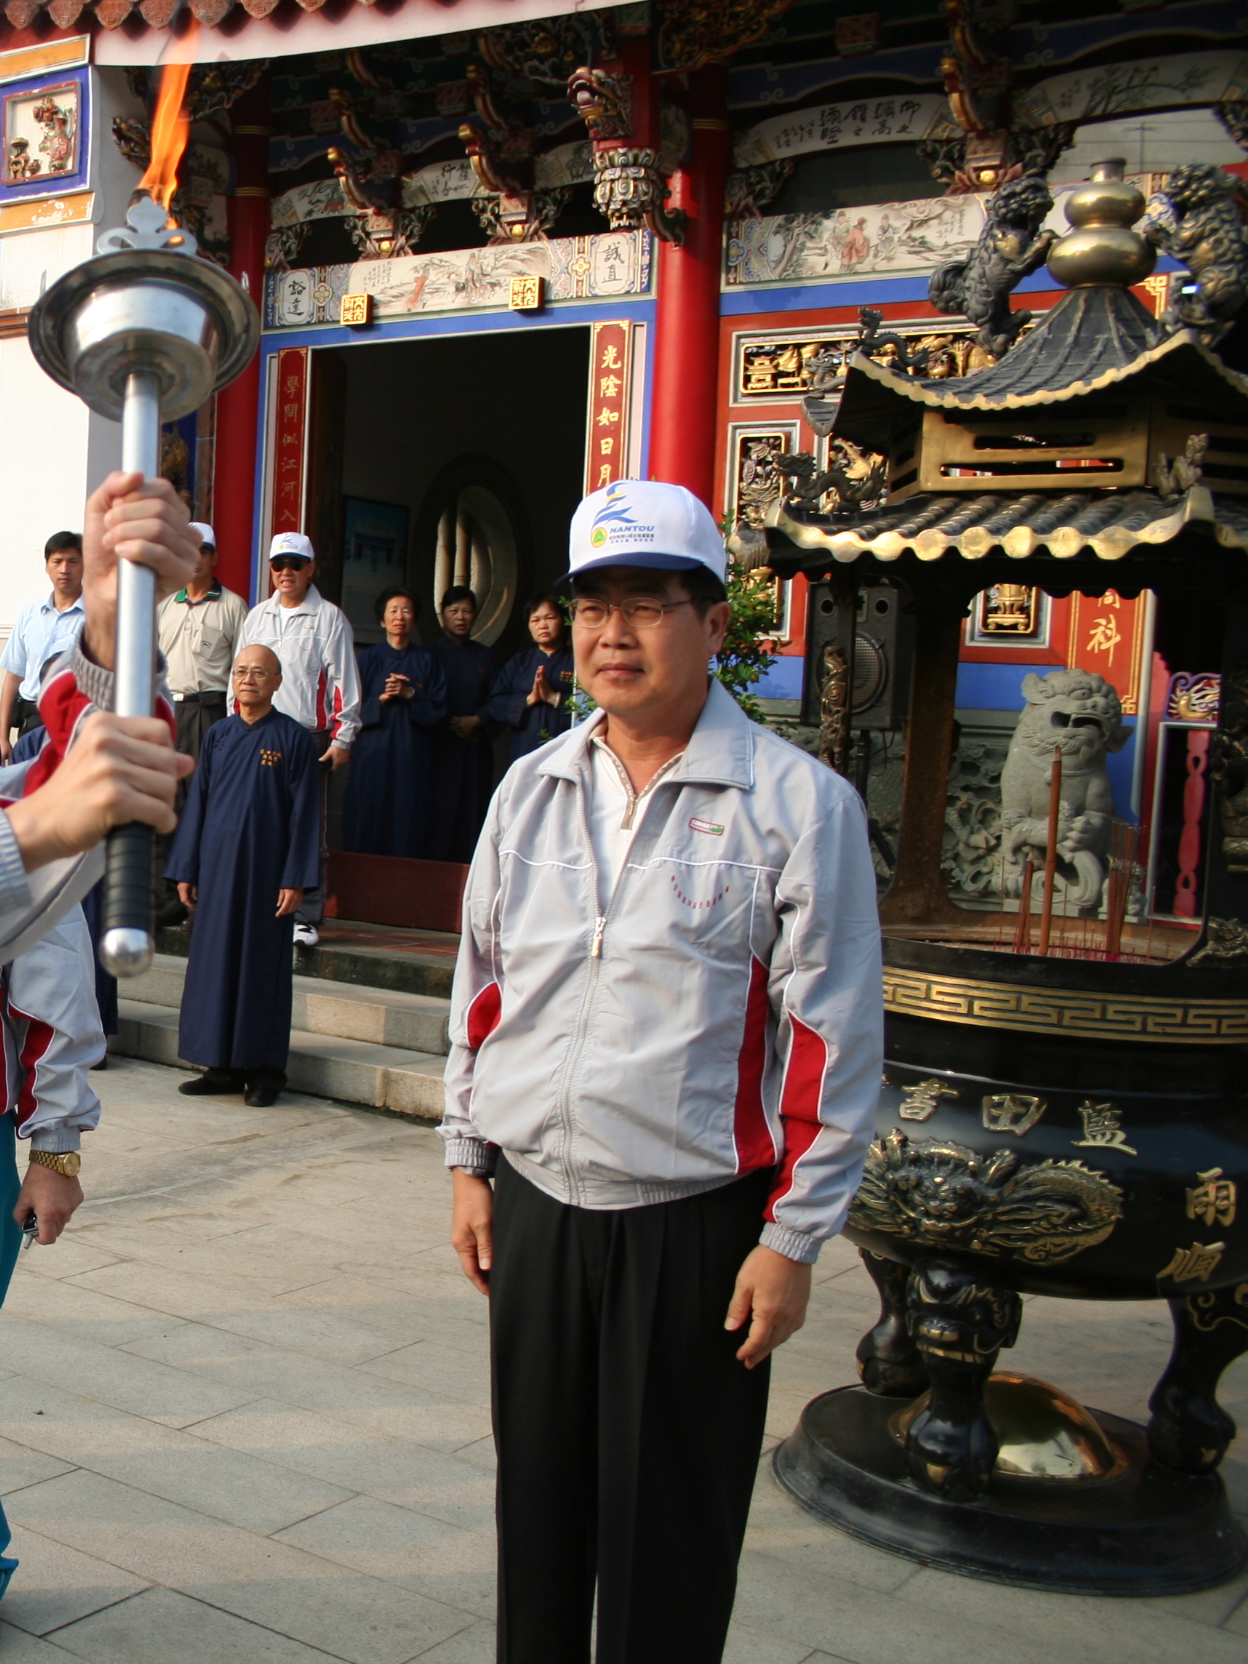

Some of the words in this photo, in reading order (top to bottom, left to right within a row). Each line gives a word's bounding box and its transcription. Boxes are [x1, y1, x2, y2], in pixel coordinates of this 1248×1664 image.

[600, 241, 625, 284] 誠直
[279, 375, 300, 522] 學問似江河入
[595, 345, 623, 488] 光陰如日月
[610, 525, 654, 533] NANTOU
[883, 1076, 1138, 1157] 藍田書
